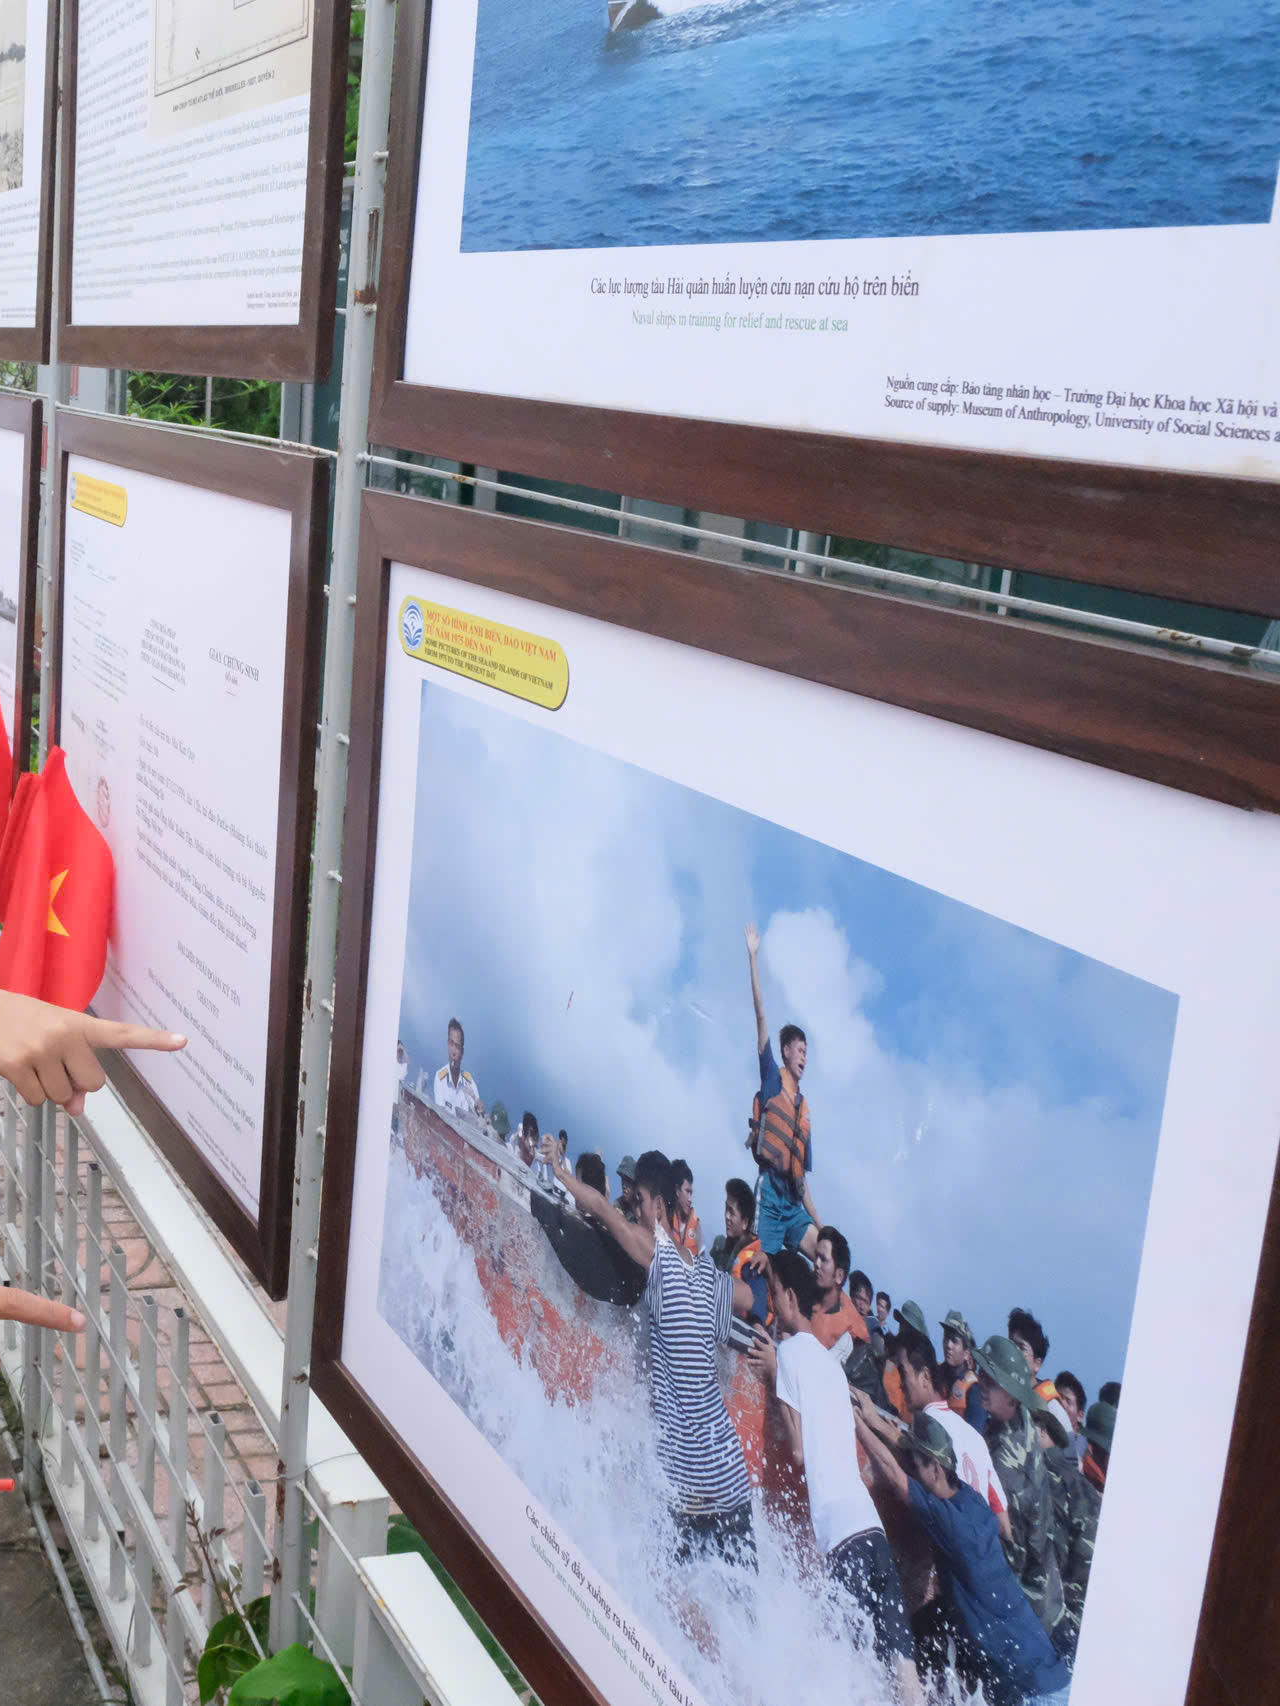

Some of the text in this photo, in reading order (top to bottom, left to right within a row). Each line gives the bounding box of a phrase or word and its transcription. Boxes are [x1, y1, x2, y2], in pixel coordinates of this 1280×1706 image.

[686, 278, 709, 299] quân
[711, 272, 736, 295] huấn
[738, 277, 767, 299] luyện
[770, 277, 791, 295] cứu
[794, 281, 815, 299] nạn
[818, 277, 840, 295] cứu
[843, 276, 859, 299] hộ
[863, 276, 887, 296] trên
[890, 270, 919, 296] biển
[723, 312, 737, 328] for
[738, 312, 764, 328] relief
[765, 314, 782, 329] and
[785, 317, 816, 330] rescue
[818, 317, 829, 331] at
[832, 319, 848, 331] sea
[917, 381, 937, 395] cung
[1032, 387, 1050, 402] học
[1107, 391, 1126, 408] Đại
[1129, 392, 1150, 411] học
[1154, 394, 1185, 411] Khoa
[1190, 396, 1212, 414] học
[1216, 399, 1234, 415] Xã
[1238, 399, 1258, 418] hội
[884, 396, 913, 409] Source
[916, 399, 926, 410] of
[927, 401, 960, 417] supply:
[962, 402, 1002, 418] Museum
[1006, 406, 1017, 419] of
[1019, 407, 1091, 429] Anthropology,
[1096, 412, 1154, 435] University
[1157, 418, 1170, 433] of
[1173, 419, 1211, 436] Social
[1215, 422, 1270, 441] Sciences
[540, 646, 557, 662] NAM
[612, 1613, 621, 1629] ra
[622, 1620, 641, 1652] biển
[611, 1634, 628, 1666] back
[629, 1659, 638, 1675] to
[638, 1671, 651, 1692] the
